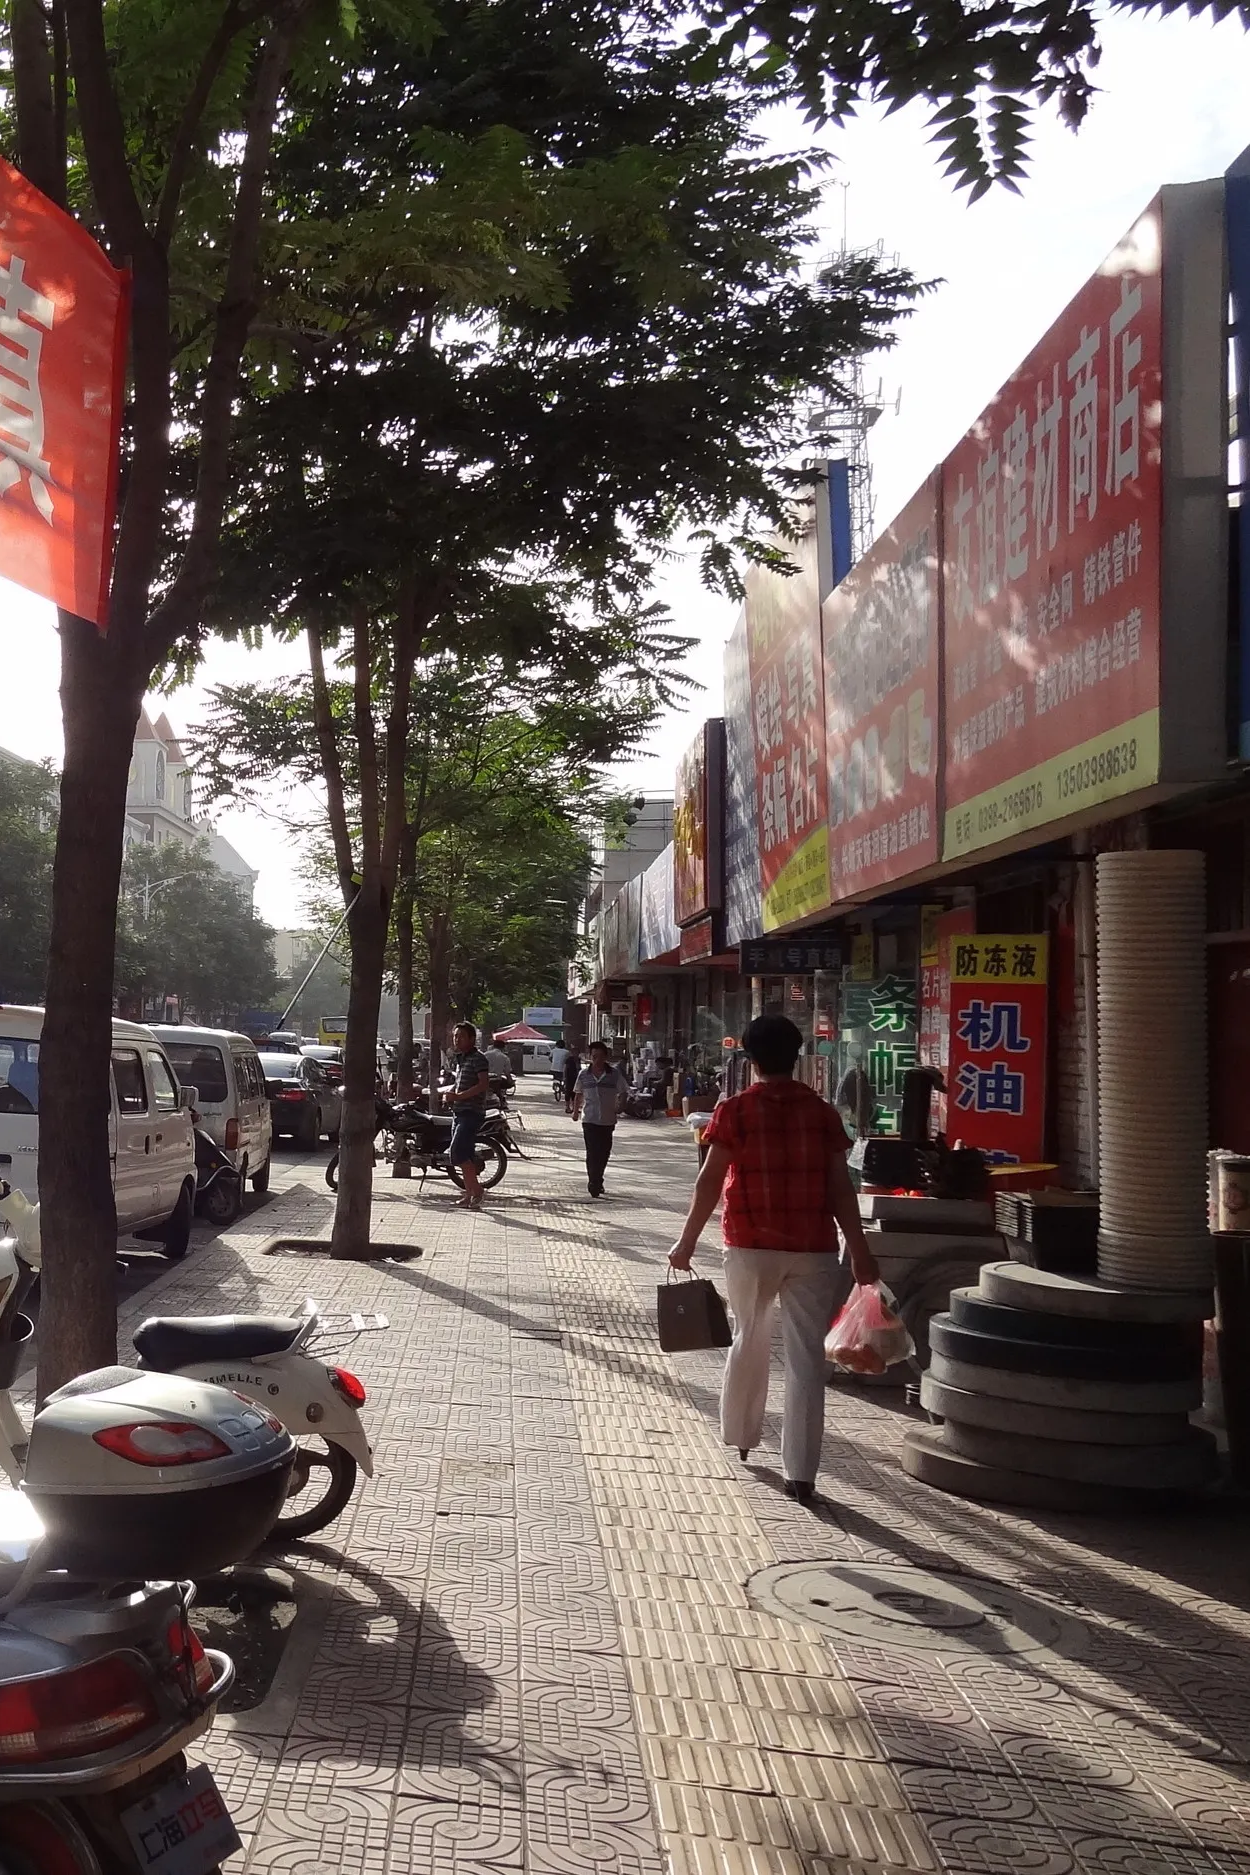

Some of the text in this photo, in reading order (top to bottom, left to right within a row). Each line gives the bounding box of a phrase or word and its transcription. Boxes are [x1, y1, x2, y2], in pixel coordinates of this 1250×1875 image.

[952, 279, 1141, 629] 友谊建材商店
[762, 758, 787, 853] 条幅
[791, 734, 819, 836] 名片
[955, 944, 1038, 978] 防冻液
[955, 1000, 1030, 1116] 机油
[203, 1373, 263, 1386] AMELLE
